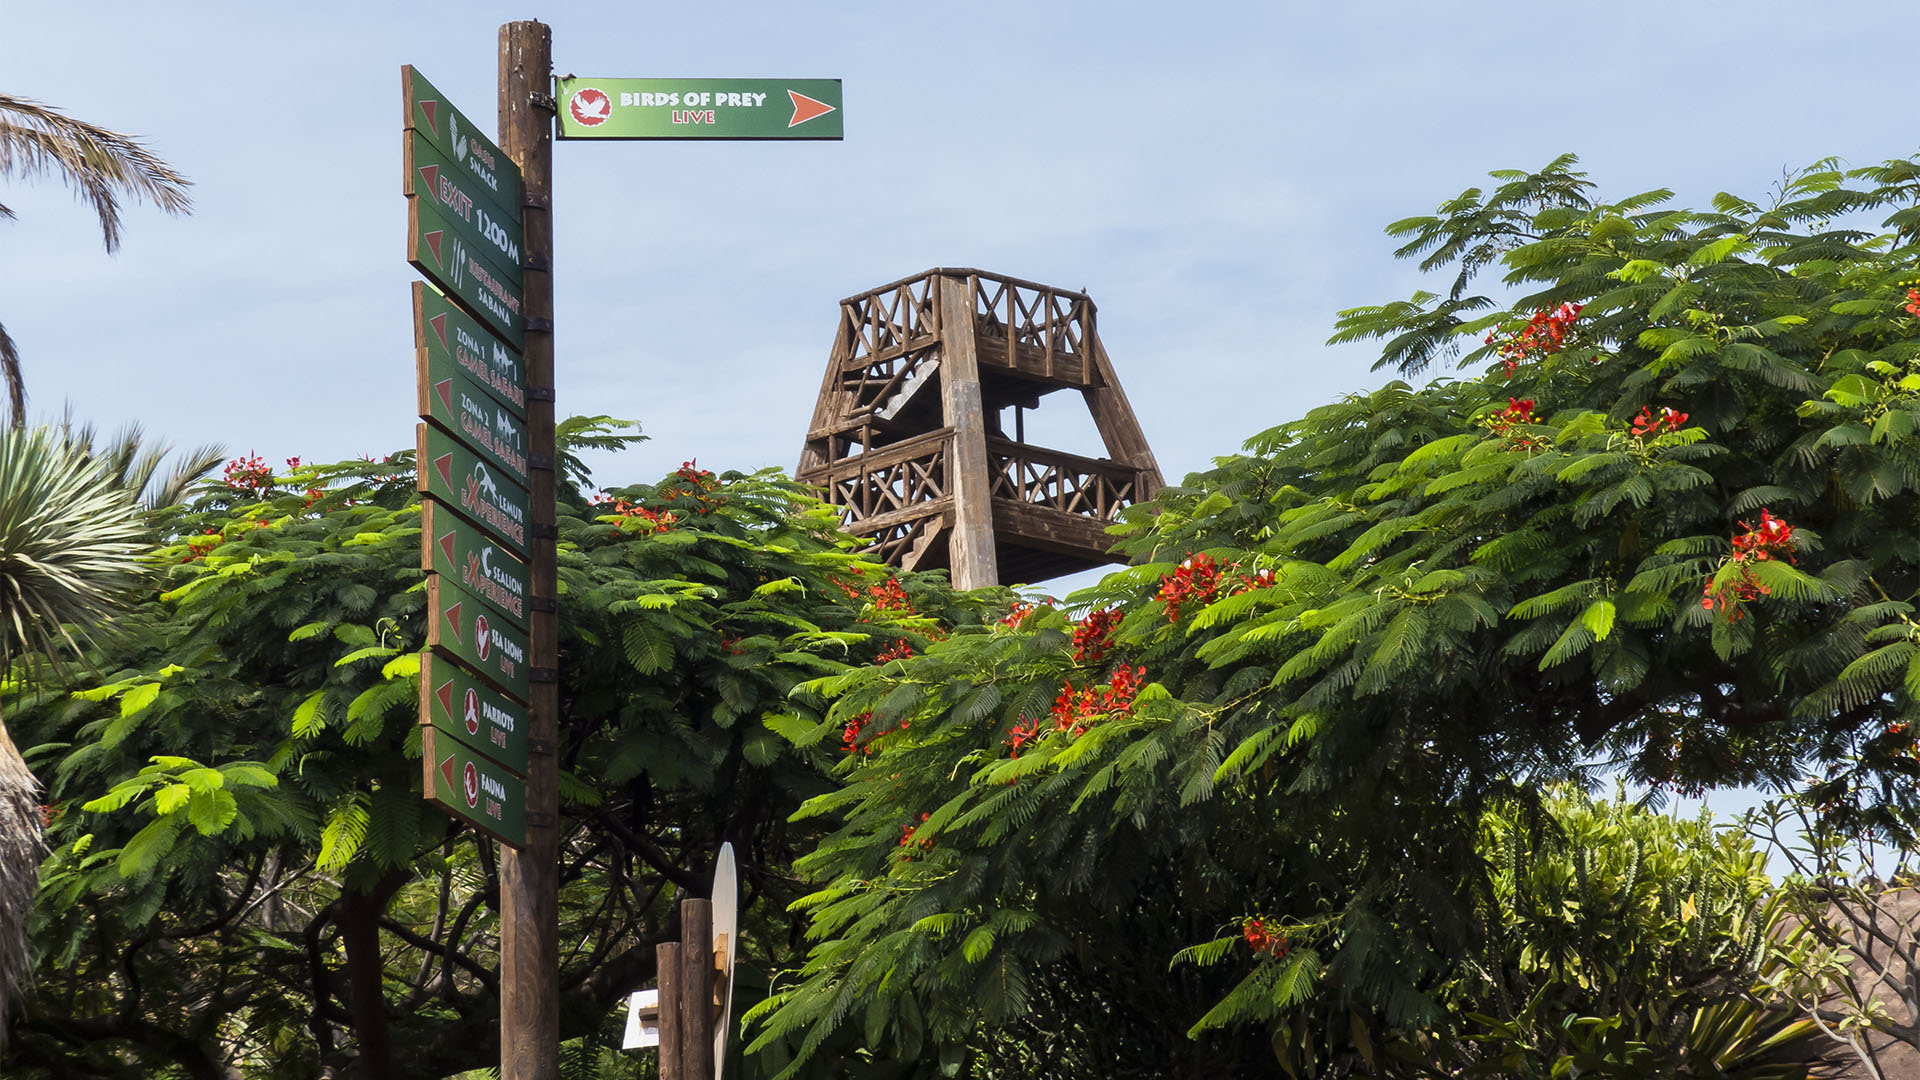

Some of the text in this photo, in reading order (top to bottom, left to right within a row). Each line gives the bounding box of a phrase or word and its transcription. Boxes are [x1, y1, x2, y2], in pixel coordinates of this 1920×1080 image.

[620, 92, 767, 107] BIRDS OF PREY
[672, 110, 716, 125] LIVE
[469, 156, 498, 192] SNACK
[440, 174, 473, 223] EXIT
[468, 257, 520, 315] RESTAURANT
[478, 288, 511, 327] SABANA
[456, 326, 480, 355] ZONA
[456, 346, 525, 408] CAMEL SAFARI
[461, 392, 484, 422] ZONA
[460, 412, 527, 478] CAMEL SAFARI
[461, 472, 524, 547] EXPERIENCE
[499, 494, 524, 523] LEMUR
[463, 550, 522, 619] EXPERIENCE
[492, 628, 522, 664] SEA LIONS
[500, 654, 514, 678] LIVE
[482, 701, 514, 732] PARROTS
[490, 726, 506, 750] LIVE
[481, 773, 506, 802] FAUNA
[486, 797, 502, 820] LIVE
